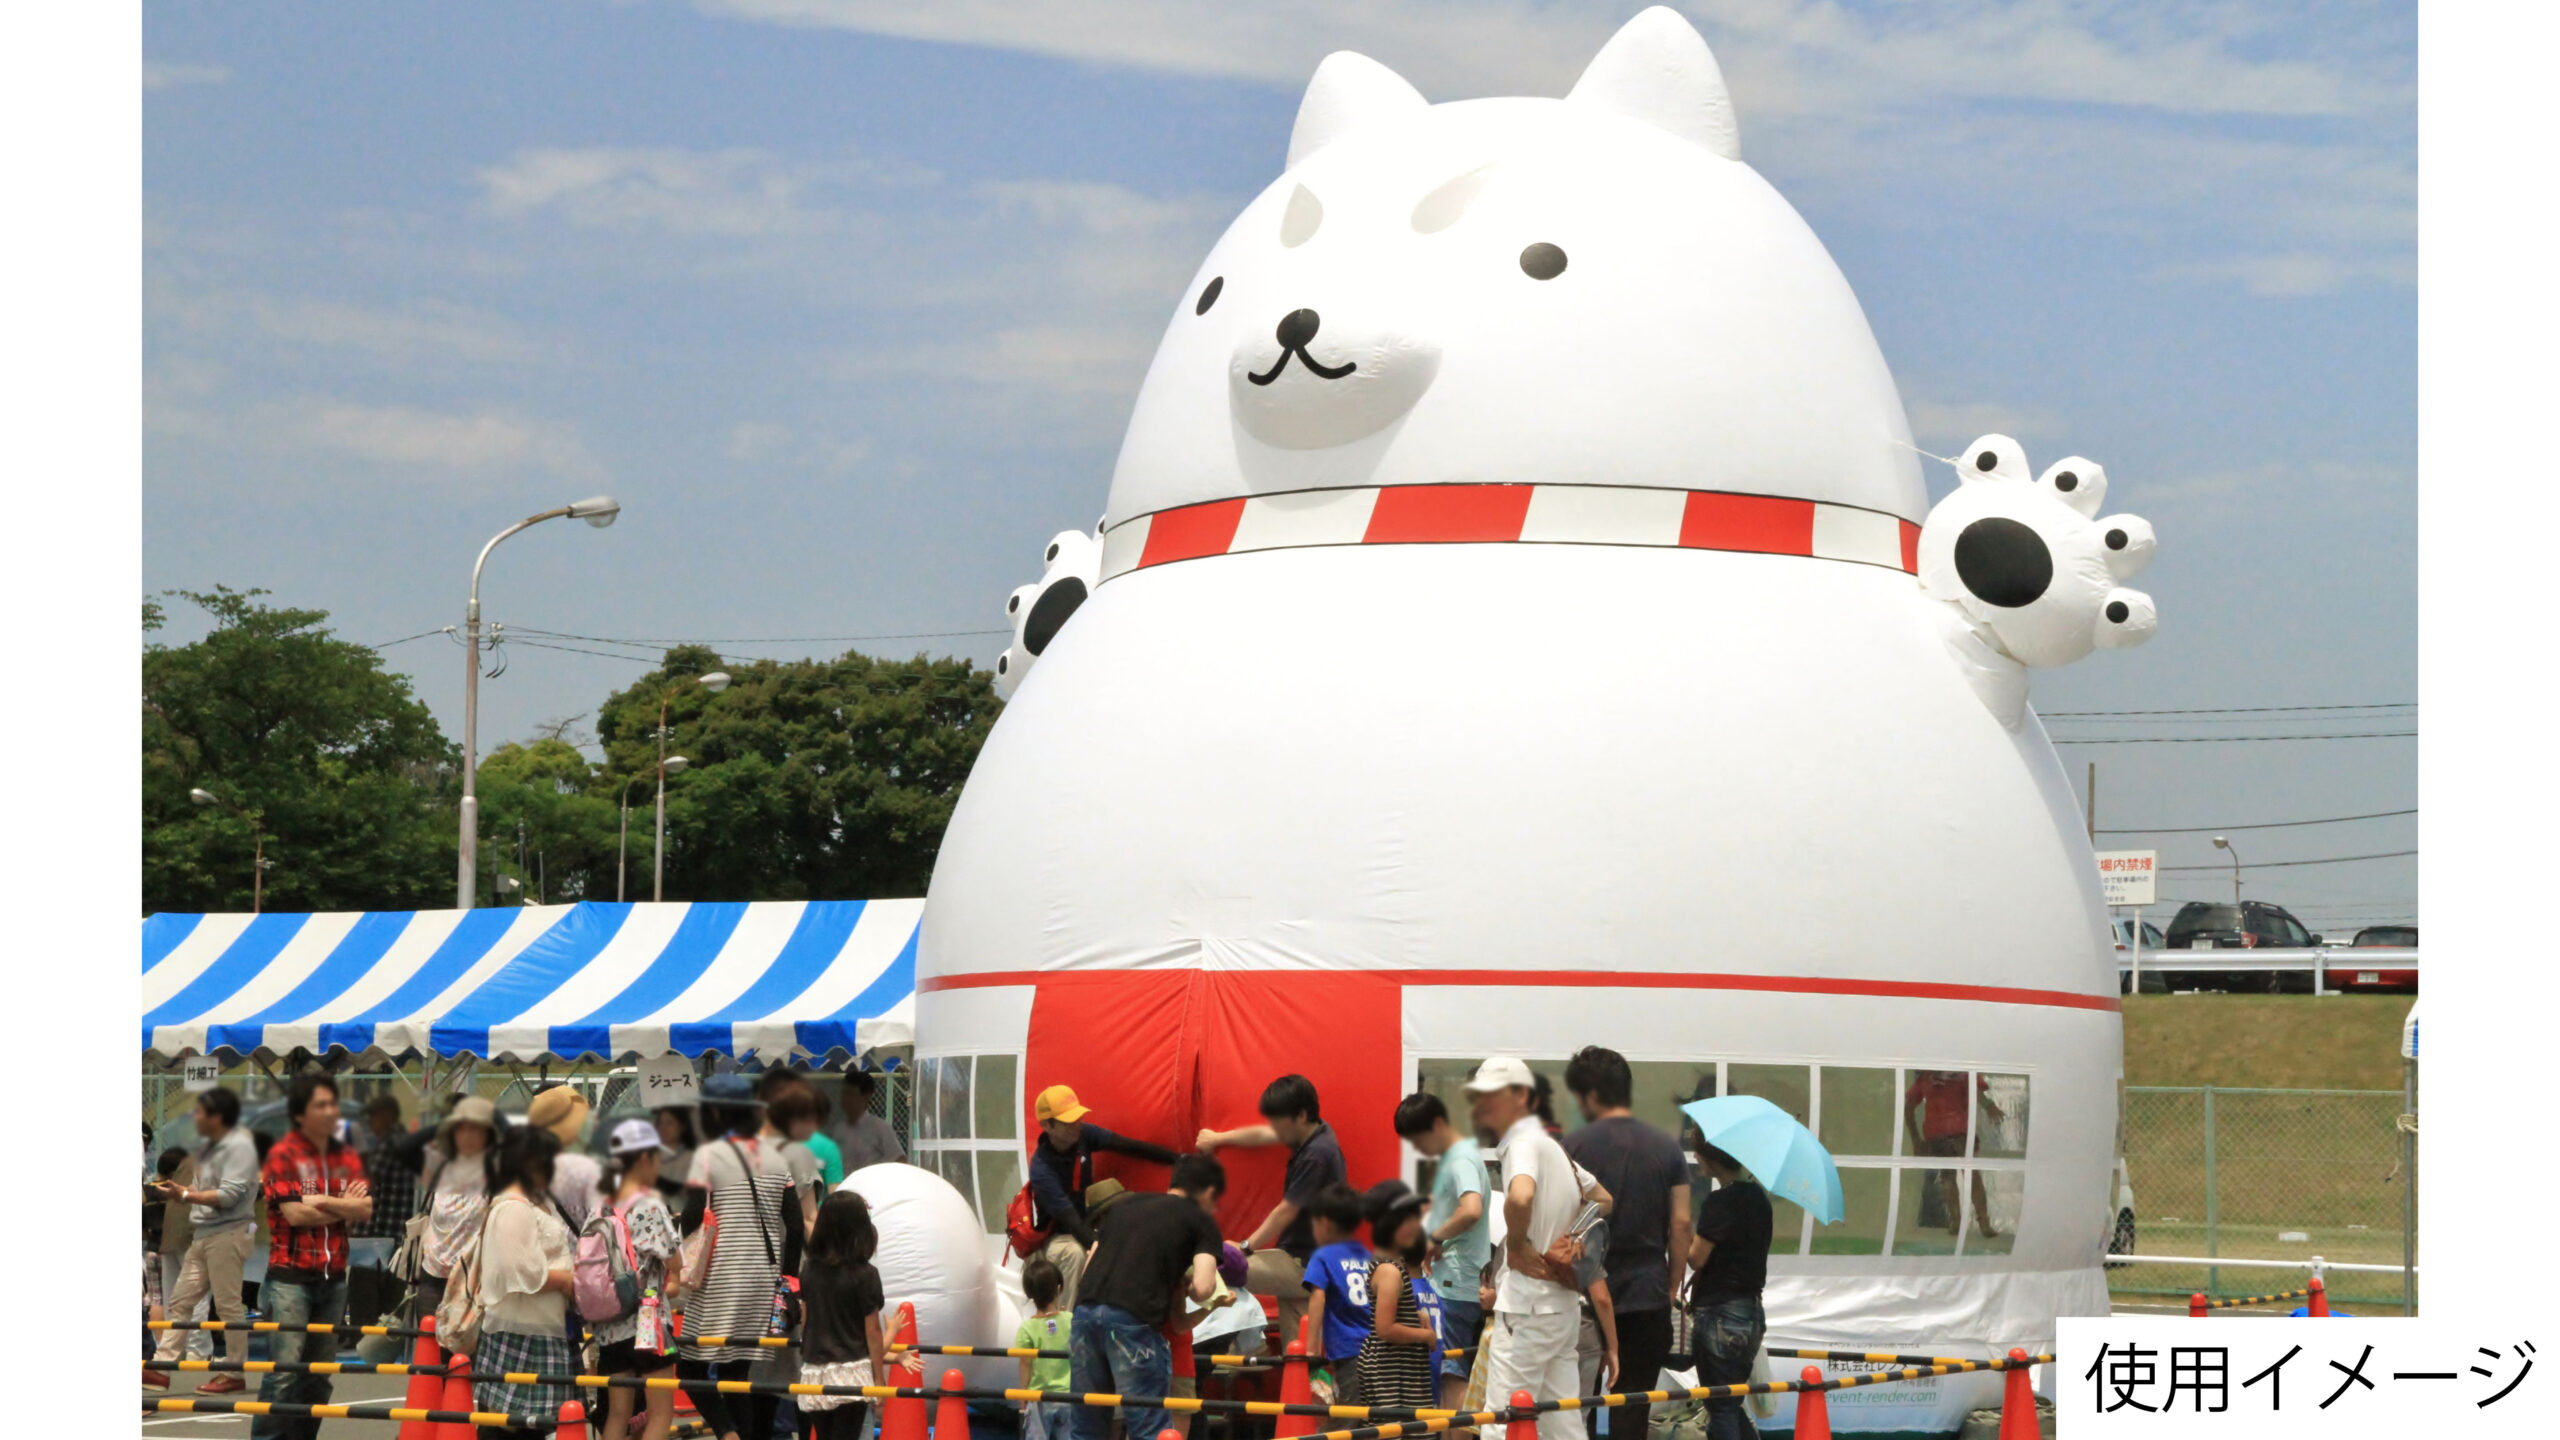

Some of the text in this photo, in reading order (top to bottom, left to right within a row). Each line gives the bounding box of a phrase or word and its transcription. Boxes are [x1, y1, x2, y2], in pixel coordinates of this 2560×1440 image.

[2096, 858, 2152, 871] 場内禁煙
[187, 1066, 217, 1081] 竹細工
[649, 1074, 693, 1088] ジュース
[1340, 1260, 1369, 1271] PALA
[1346, 1272, 1369, 1306] 8
